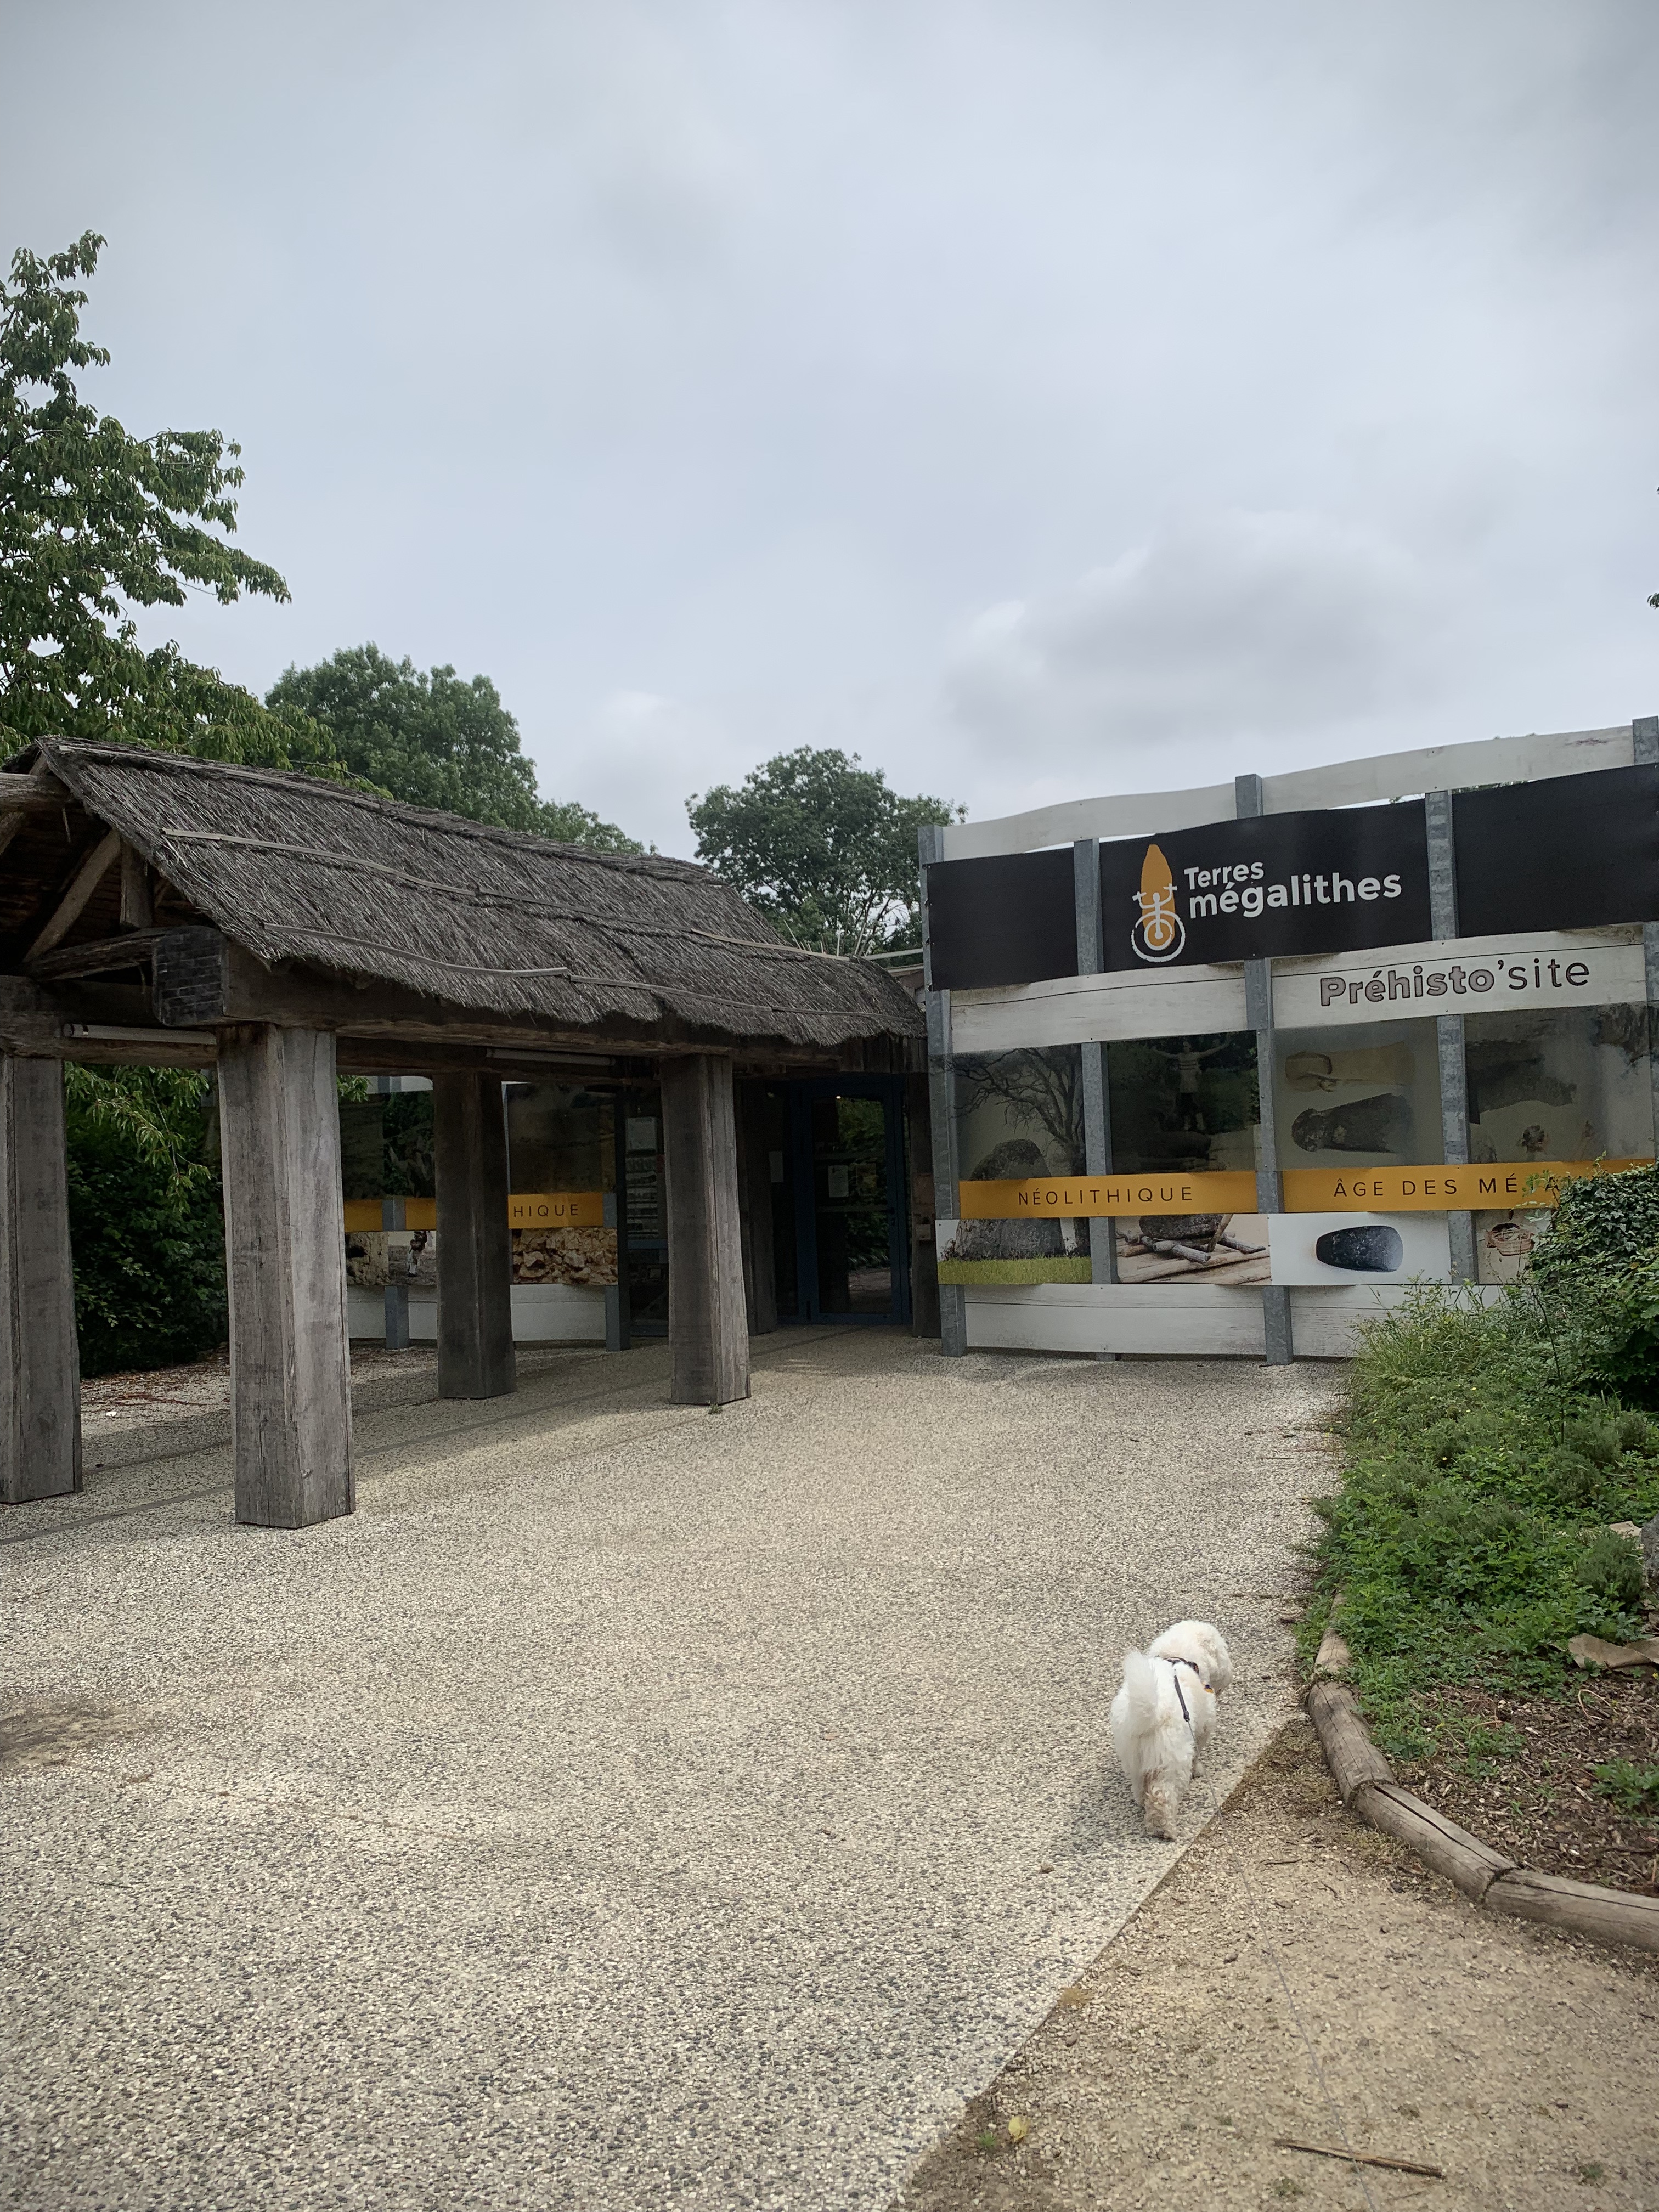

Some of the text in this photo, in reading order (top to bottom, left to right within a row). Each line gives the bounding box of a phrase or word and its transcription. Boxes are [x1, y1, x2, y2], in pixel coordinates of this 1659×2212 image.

[1184, 861, 1265, 890] Terres
[1189, 872, 1402, 918] mégalithes
[1319, 958, 1590, 1007] Préhisto'site
[1019, 1188, 1192, 1205] NÉOLITHIQUE
[1334, 1178, 1384, 1197] ÂGE
[1402, 1179, 1457, 1195] DES
[514, 1204, 578, 1217] HIQUE
